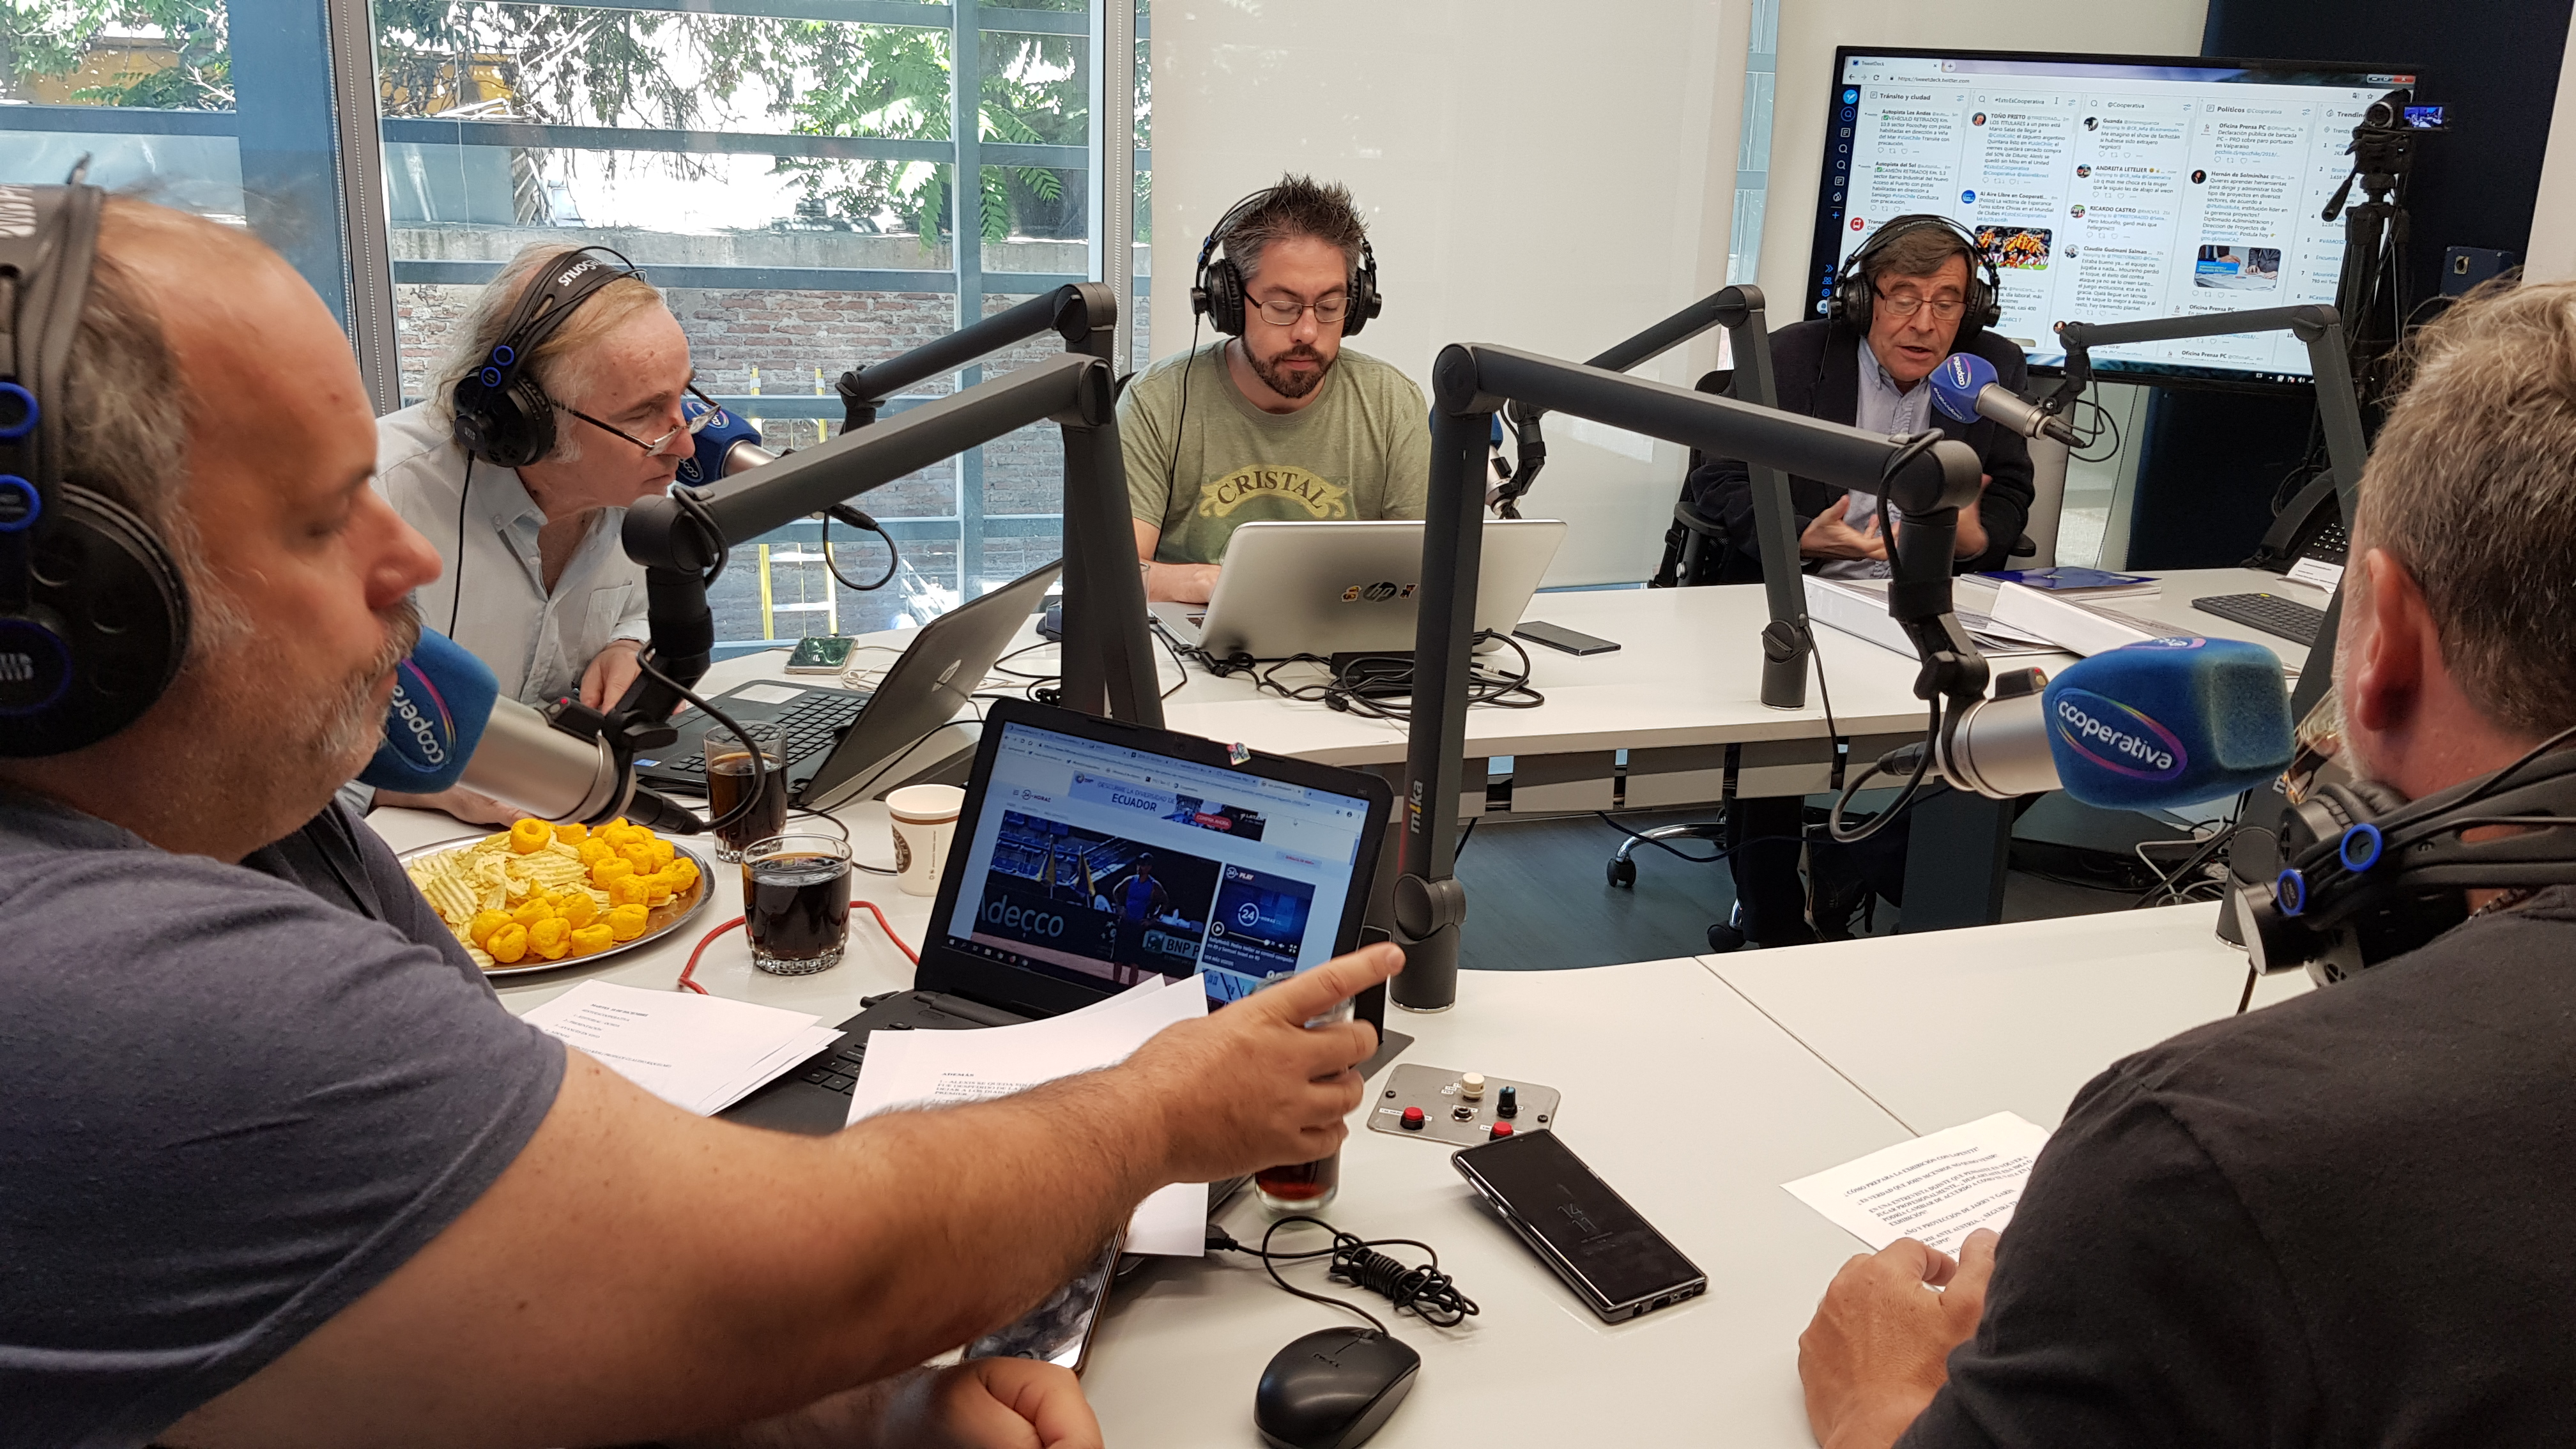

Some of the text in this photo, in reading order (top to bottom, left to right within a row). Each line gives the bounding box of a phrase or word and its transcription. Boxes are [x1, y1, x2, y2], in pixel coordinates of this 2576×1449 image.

[1218, 470, 1326, 509] CRISTAL
[391, 684, 445, 764] coopera
[2058, 701, 2173, 770] cooperativa
[1098, 781, 1126, 792] DESCUBRE
[1135, 789, 1167, 802] DIVERSIDAD
[1168, 796, 1176, 804] DE
[1112, 793, 1156, 811] ECUADOR
[1409, 780, 1423, 834] mika
[1241, 909, 1255, 921] 24
[1165, 936, 1190, 954] BNP
[1866, 1175, 1894, 1188] PREPARA
[1902, 1159, 1937, 1173] EXHIBICIÓN
[1868, 1188, 1893, 1200] VERDAD
[1906, 1177, 1923, 1185] JOHN
[1922, 1165, 1953, 1178] MCENROE
[1891, 1189, 1929, 1205] ENTREVISTA
[1928, 1179, 1951, 1191] DIJISTE
[1964, 1167, 1992, 1175] PENSASTE
[2000, 1158, 2023, 1168] VOLVER
[1876, 1208, 1897, 1217] JUGAR
[1964, 1172, 2001, 1183] DESCARTASTE
[1882, 1211, 1907, 1222] PODRÍA
[1906, 1201, 1935, 1213] CAMBIAR
[1944, 1184, 1972, 1199] ACUERDO
[1889, 1210, 1928, 1227] EXHIBICIÓN?
[1922, 1211, 1963, 1229] PROYECCIÓN
[1971, 1198, 1990, 1209] JARRY
[1936, 1230, 1954, 1238] ANTE
[1952, 1219, 1981, 1232] AUSTRIA.
[1984, 1205, 2011, 1218] SEGUIRÁ
